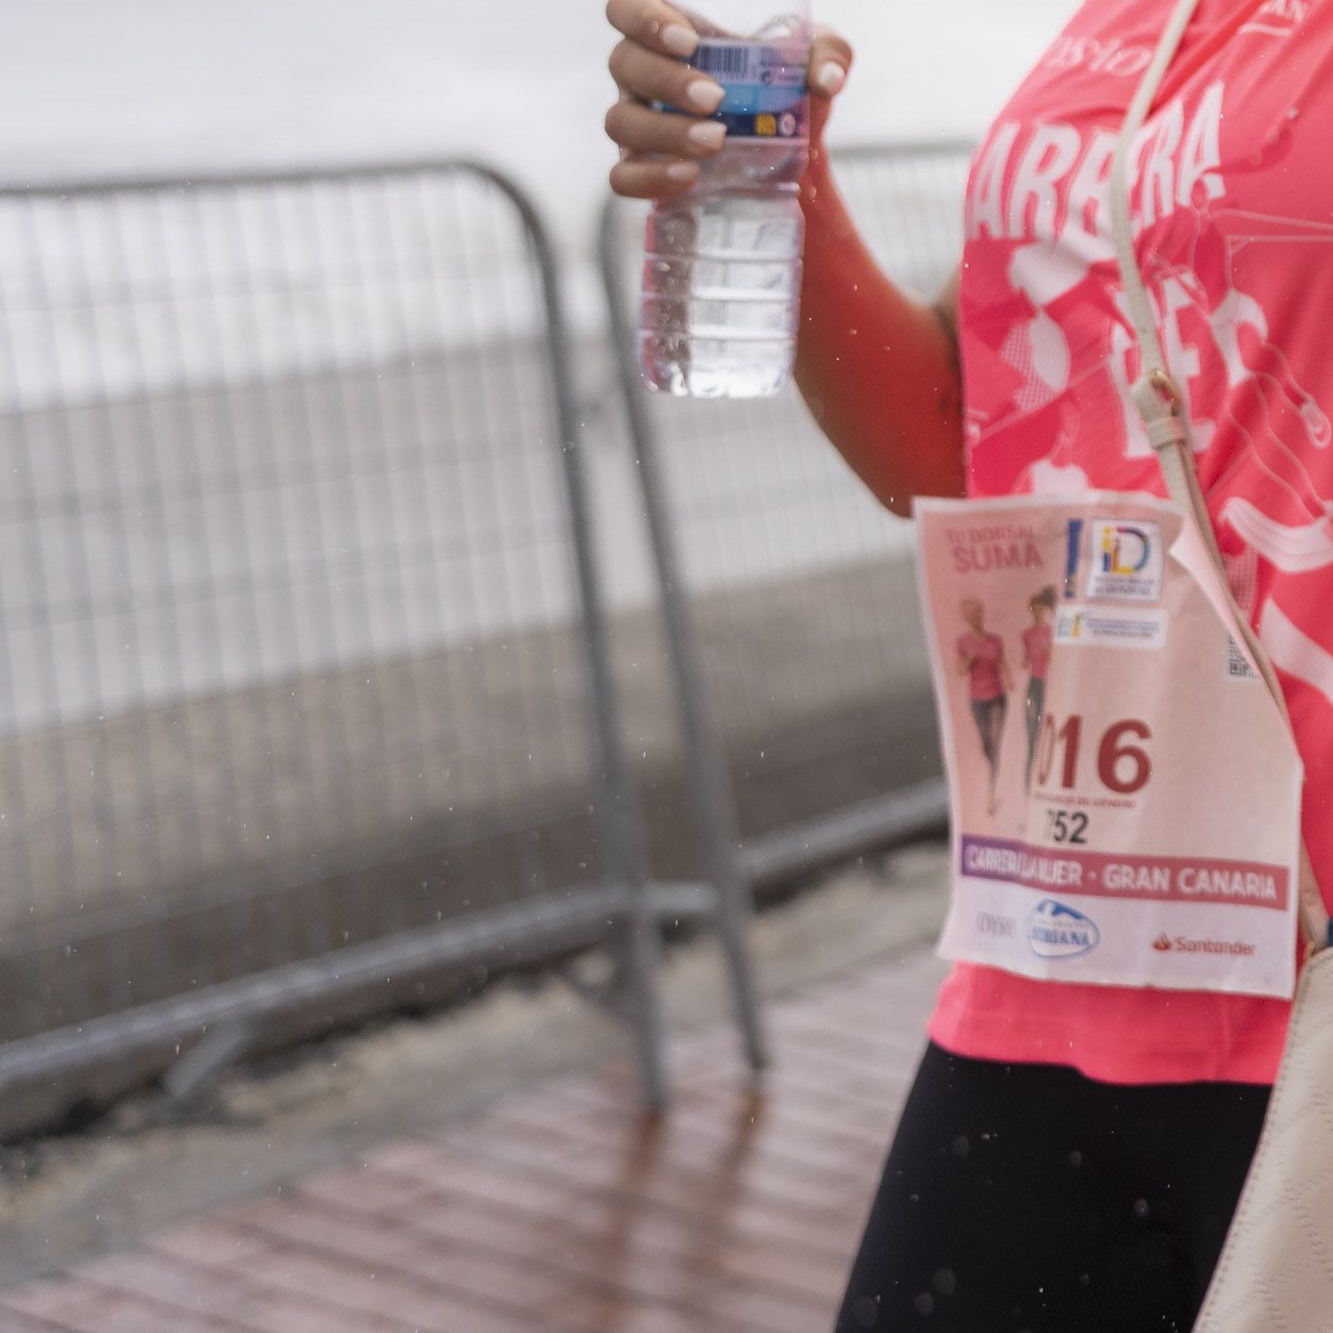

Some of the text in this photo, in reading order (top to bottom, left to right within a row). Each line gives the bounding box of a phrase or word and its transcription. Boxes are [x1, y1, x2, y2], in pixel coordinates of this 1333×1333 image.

[953, 542, 1045, 573] SUMA
[1104, 862, 1171, 892] GRAN
[1177, 867, 1277, 899] CANARIA
[1174, 935, 1256, 956] Santander
